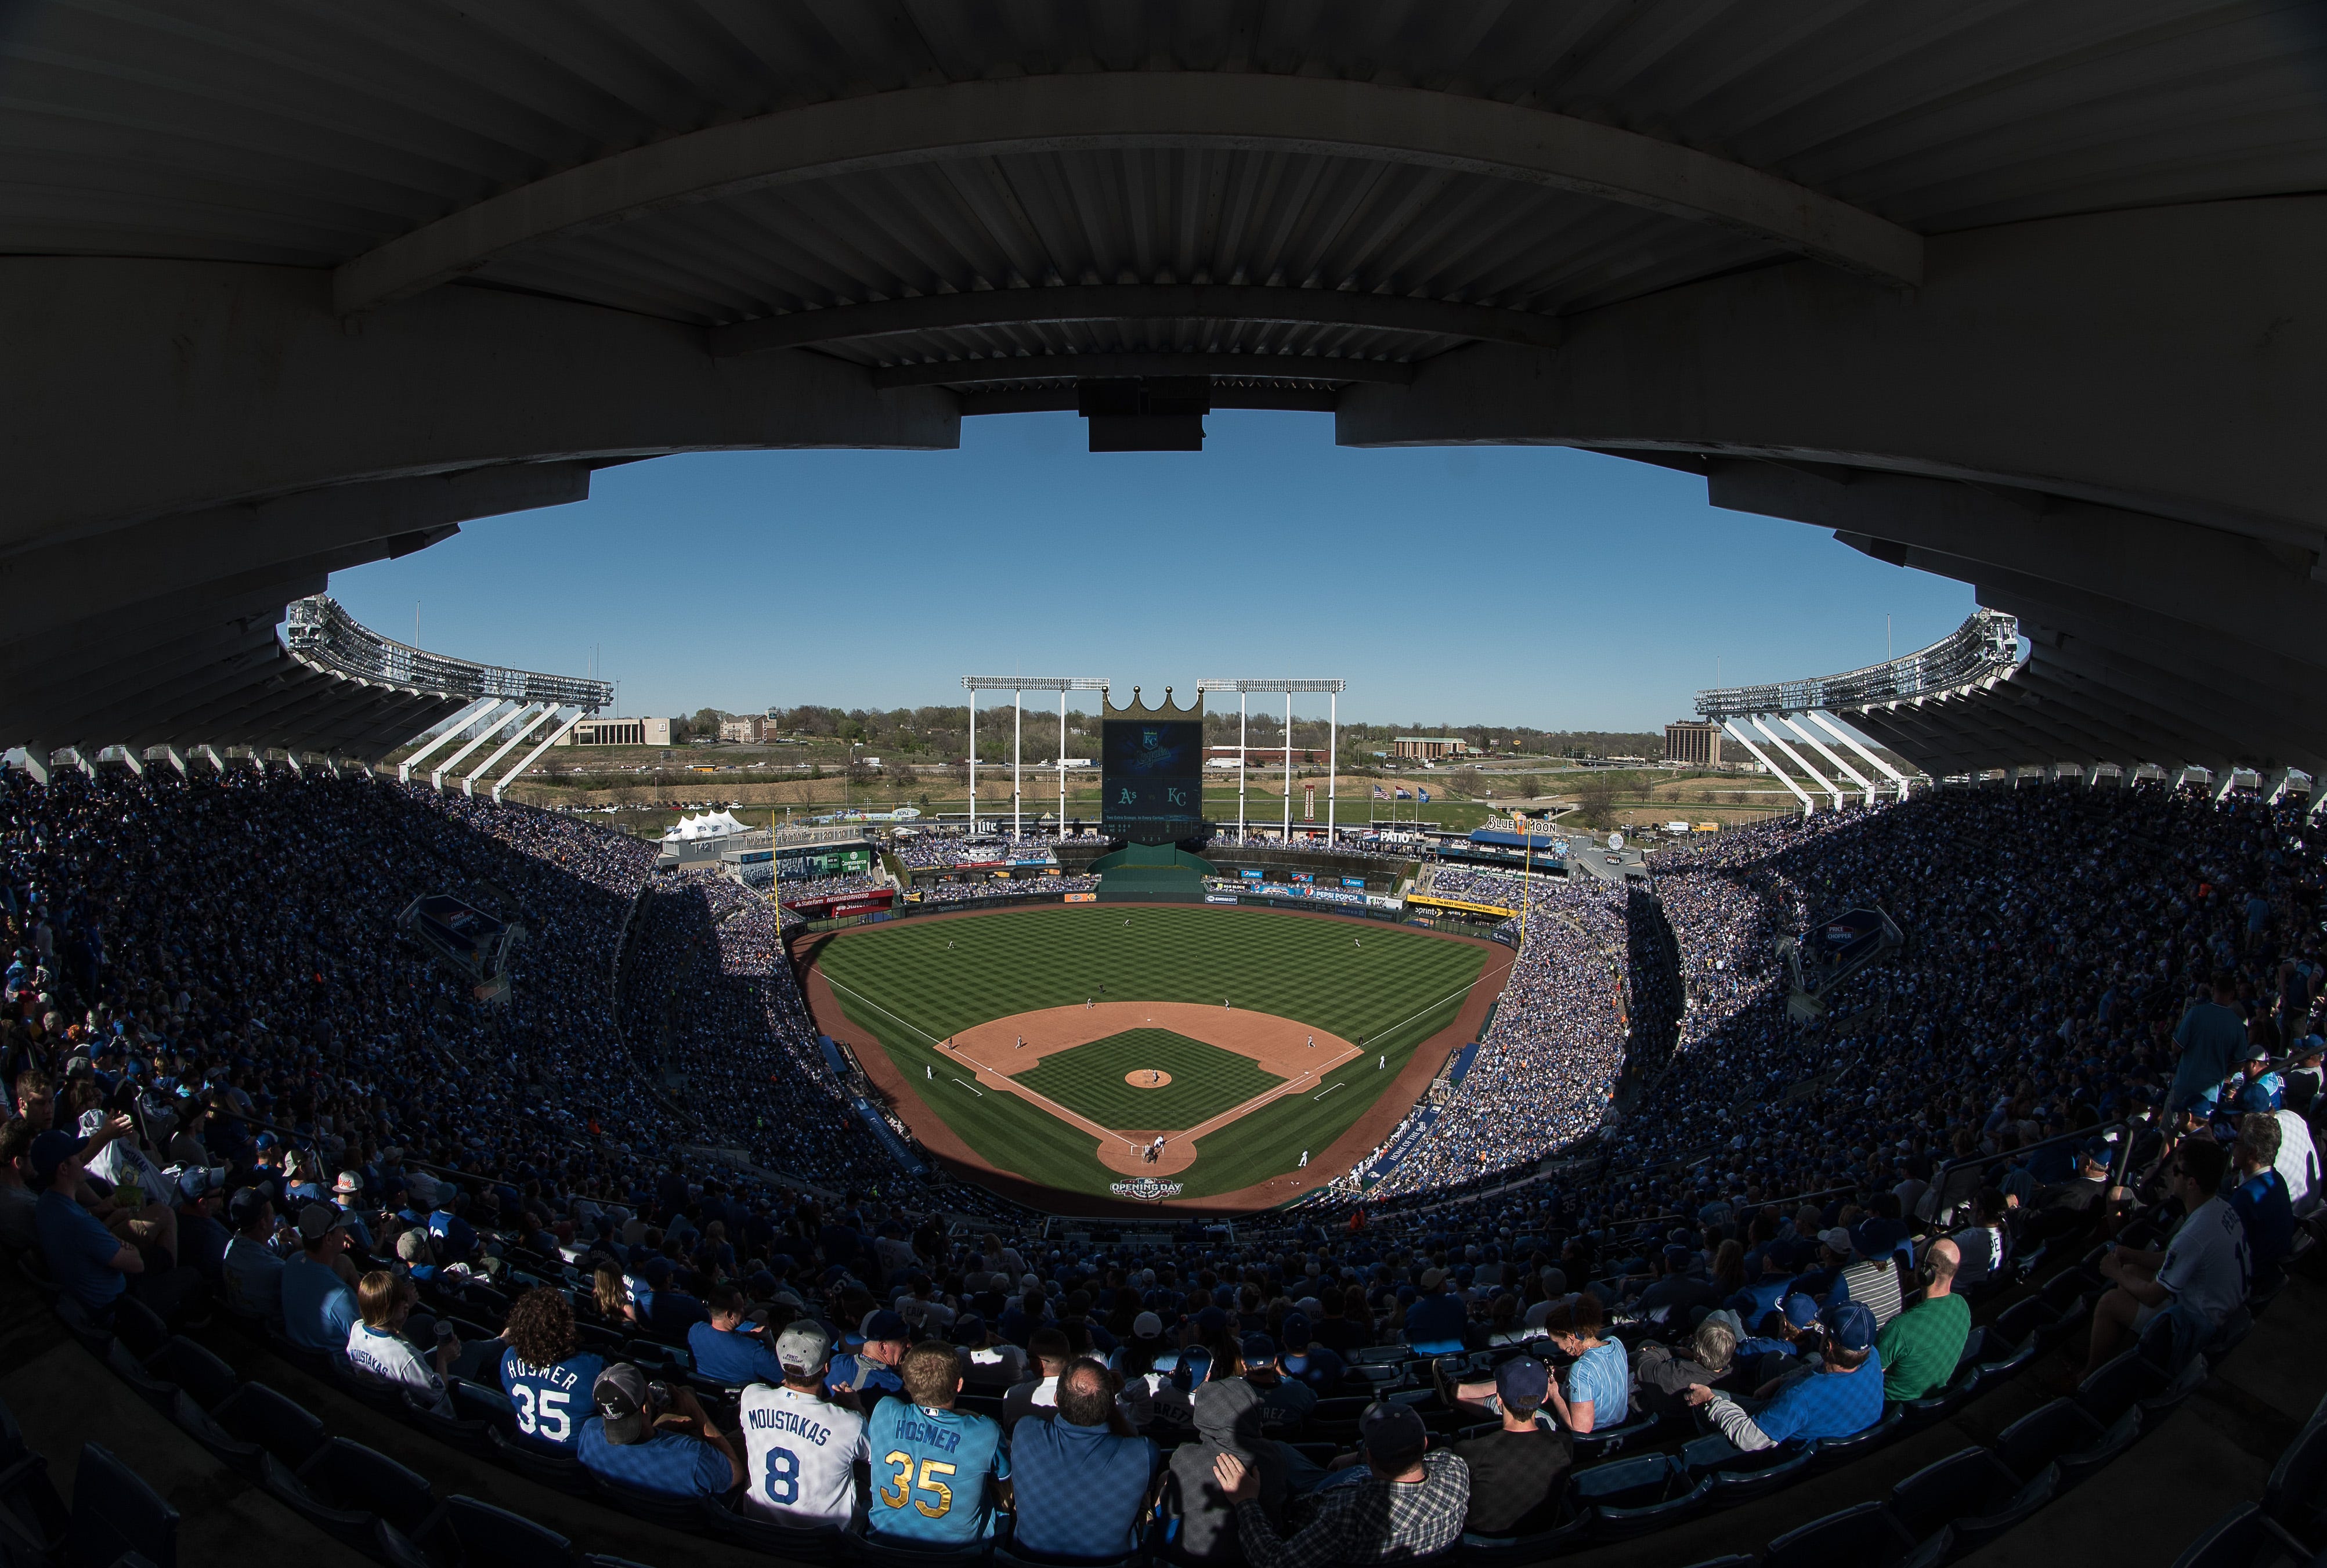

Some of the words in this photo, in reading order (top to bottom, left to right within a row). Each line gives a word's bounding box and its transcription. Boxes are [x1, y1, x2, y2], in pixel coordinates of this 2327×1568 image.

[1145, 735, 1157, 746] KC
[1118, 787, 1137, 805] A's
[1167, 787, 1186, 807] KC
[978, 821, 998, 834] Lite
[1487, 815, 1513, 830] BLUE
[1527, 819, 1556, 833] MOON
[745, 836, 771, 846] HALL
[781, 832, 808, 843] FAME
[822, 831, 832, 840] 20
[839, 829, 846, 839] 10
[1381, 831, 1410, 843] PATIO
[699, 842, 711, 851] 42
[780, 858, 798, 872] City
[826, 893, 869, 902] NEIGHBORHOOD
[1335, 893, 1358, 901] PORCH
[938, 904, 963, 912] Spectrum
[1415, 907, 1434, 915] Sprint
[450, 912, 465, 922] PRICE
[451, 915, 474, 928] CHOPPER
[886, 1137, 906, 1158] STADIUM
[1389, 1146, 1407, 1161] HOME
[1407, 1131, 1421, 1141] THE
[1562, 1201, 1577, 1213] 35
[590, 1250, 616, 1262] GORDON
[906, 1306, 926, 1317] CAIN
[349, 1348, 389, 1378] MOUSTAKAS
[1182, 1363, 1192, 1376] KC
[507, 1357, 578, 1391] HOSMER
[511, 1383, 571, 1443] 35
[747, 1407, 832, 1446] MOUSTAKAS
[895, 1419, 961, 1454] HOSMER
[765, 1446, 800, 1505] 8
[879, 1449, 957, 1519] 35
